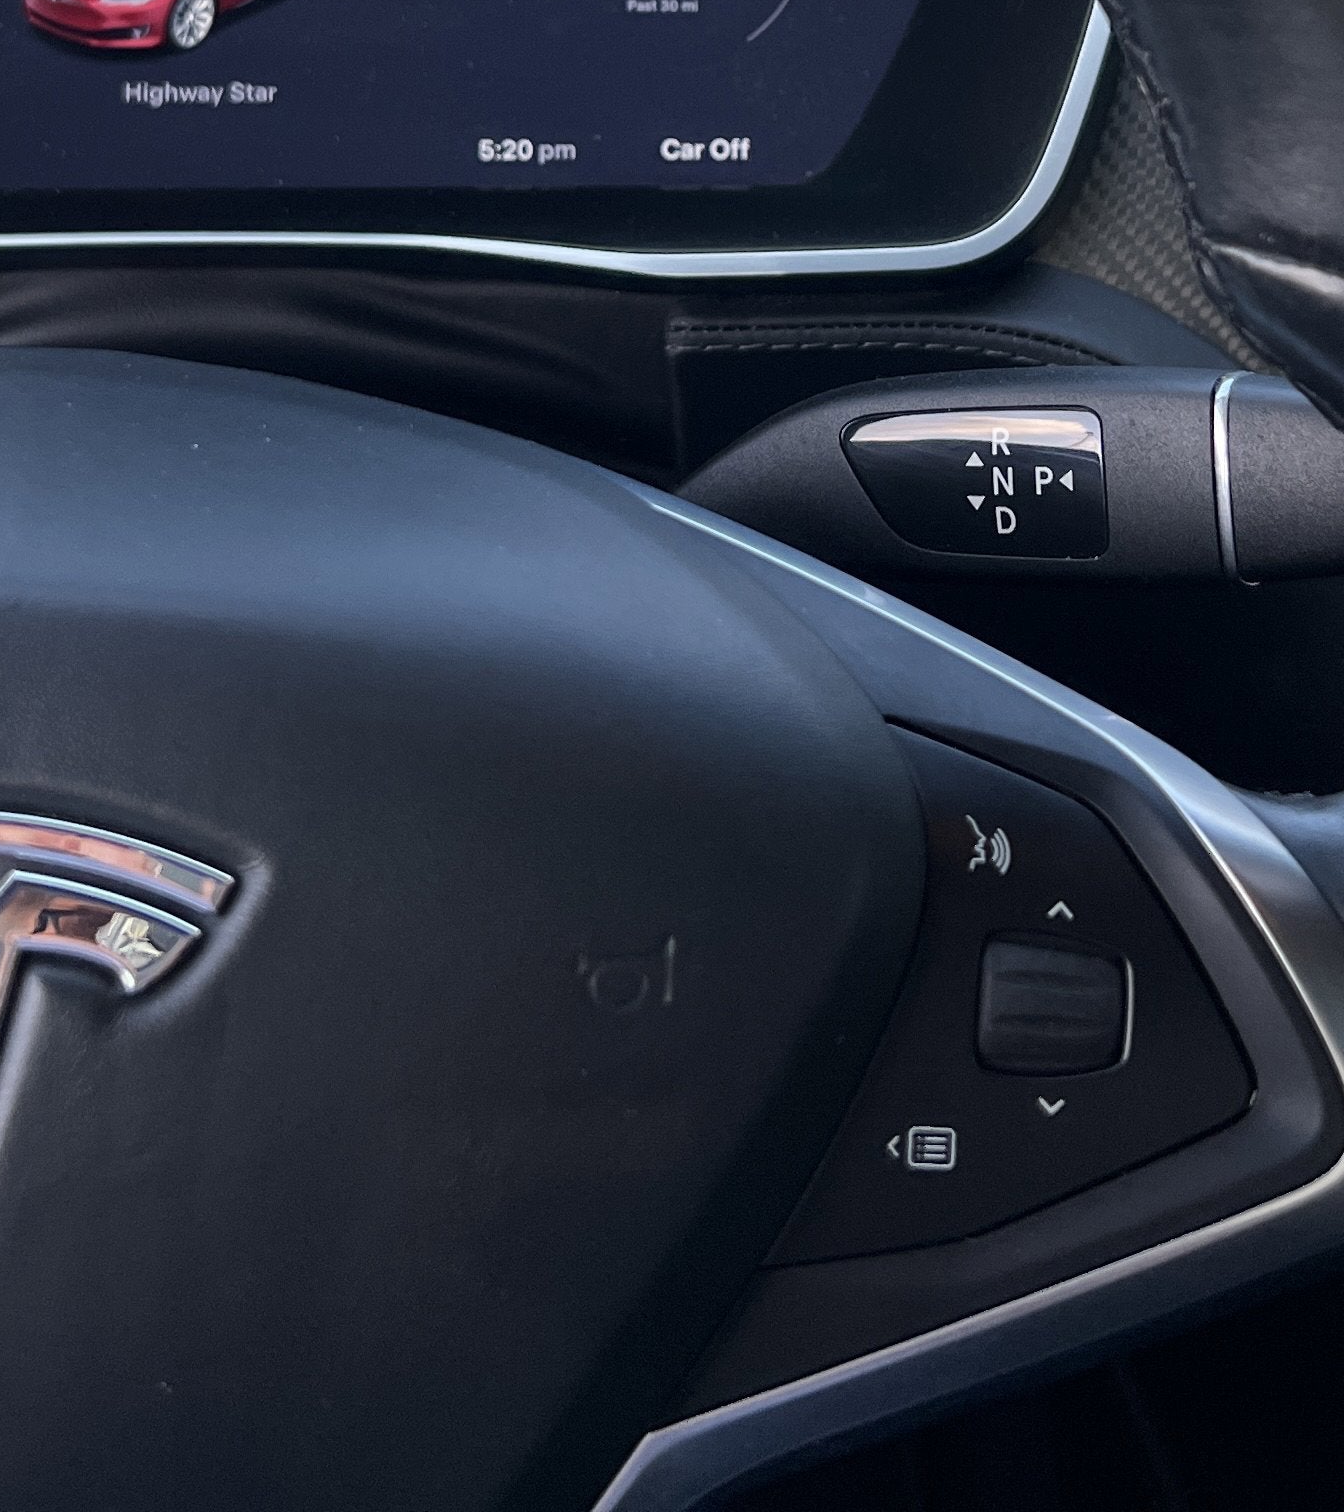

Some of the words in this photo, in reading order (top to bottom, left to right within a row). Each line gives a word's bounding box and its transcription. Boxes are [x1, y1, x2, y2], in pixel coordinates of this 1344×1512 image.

[123, 80, 224, 109] Highway
[228, 80, 278, 105] Star
[477, 138, 534, 163] 5:20
[537, 142, 577, 166] pm
[659, 137, 706, 162] Car
[708, 137, 751, 162] Off
[991, 427, 1012, 456] R
[992, 466, 1014, 496] N
[1034, 465, 1054, 496] P
[995, 506, 1016, 535] D
